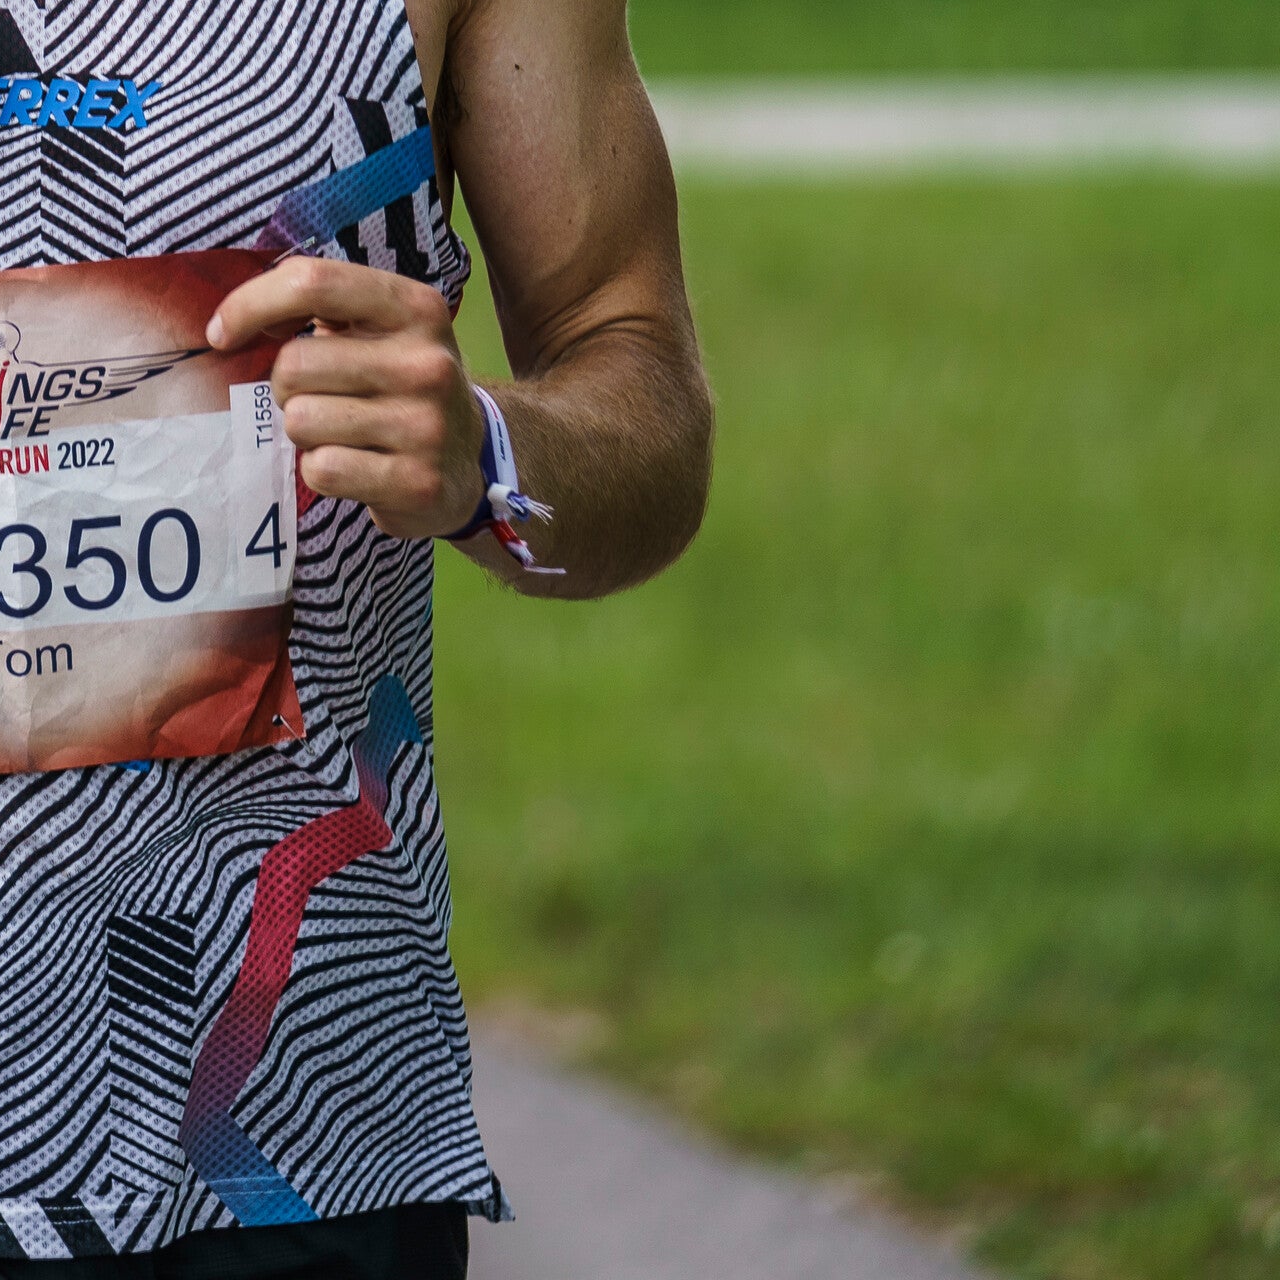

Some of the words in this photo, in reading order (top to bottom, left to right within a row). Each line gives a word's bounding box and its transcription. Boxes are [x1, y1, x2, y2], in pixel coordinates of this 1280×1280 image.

[253, 384, 273, 449] T1559
[57, 437, 116, 470] 2022
[245, 501, 288, 570] 4
